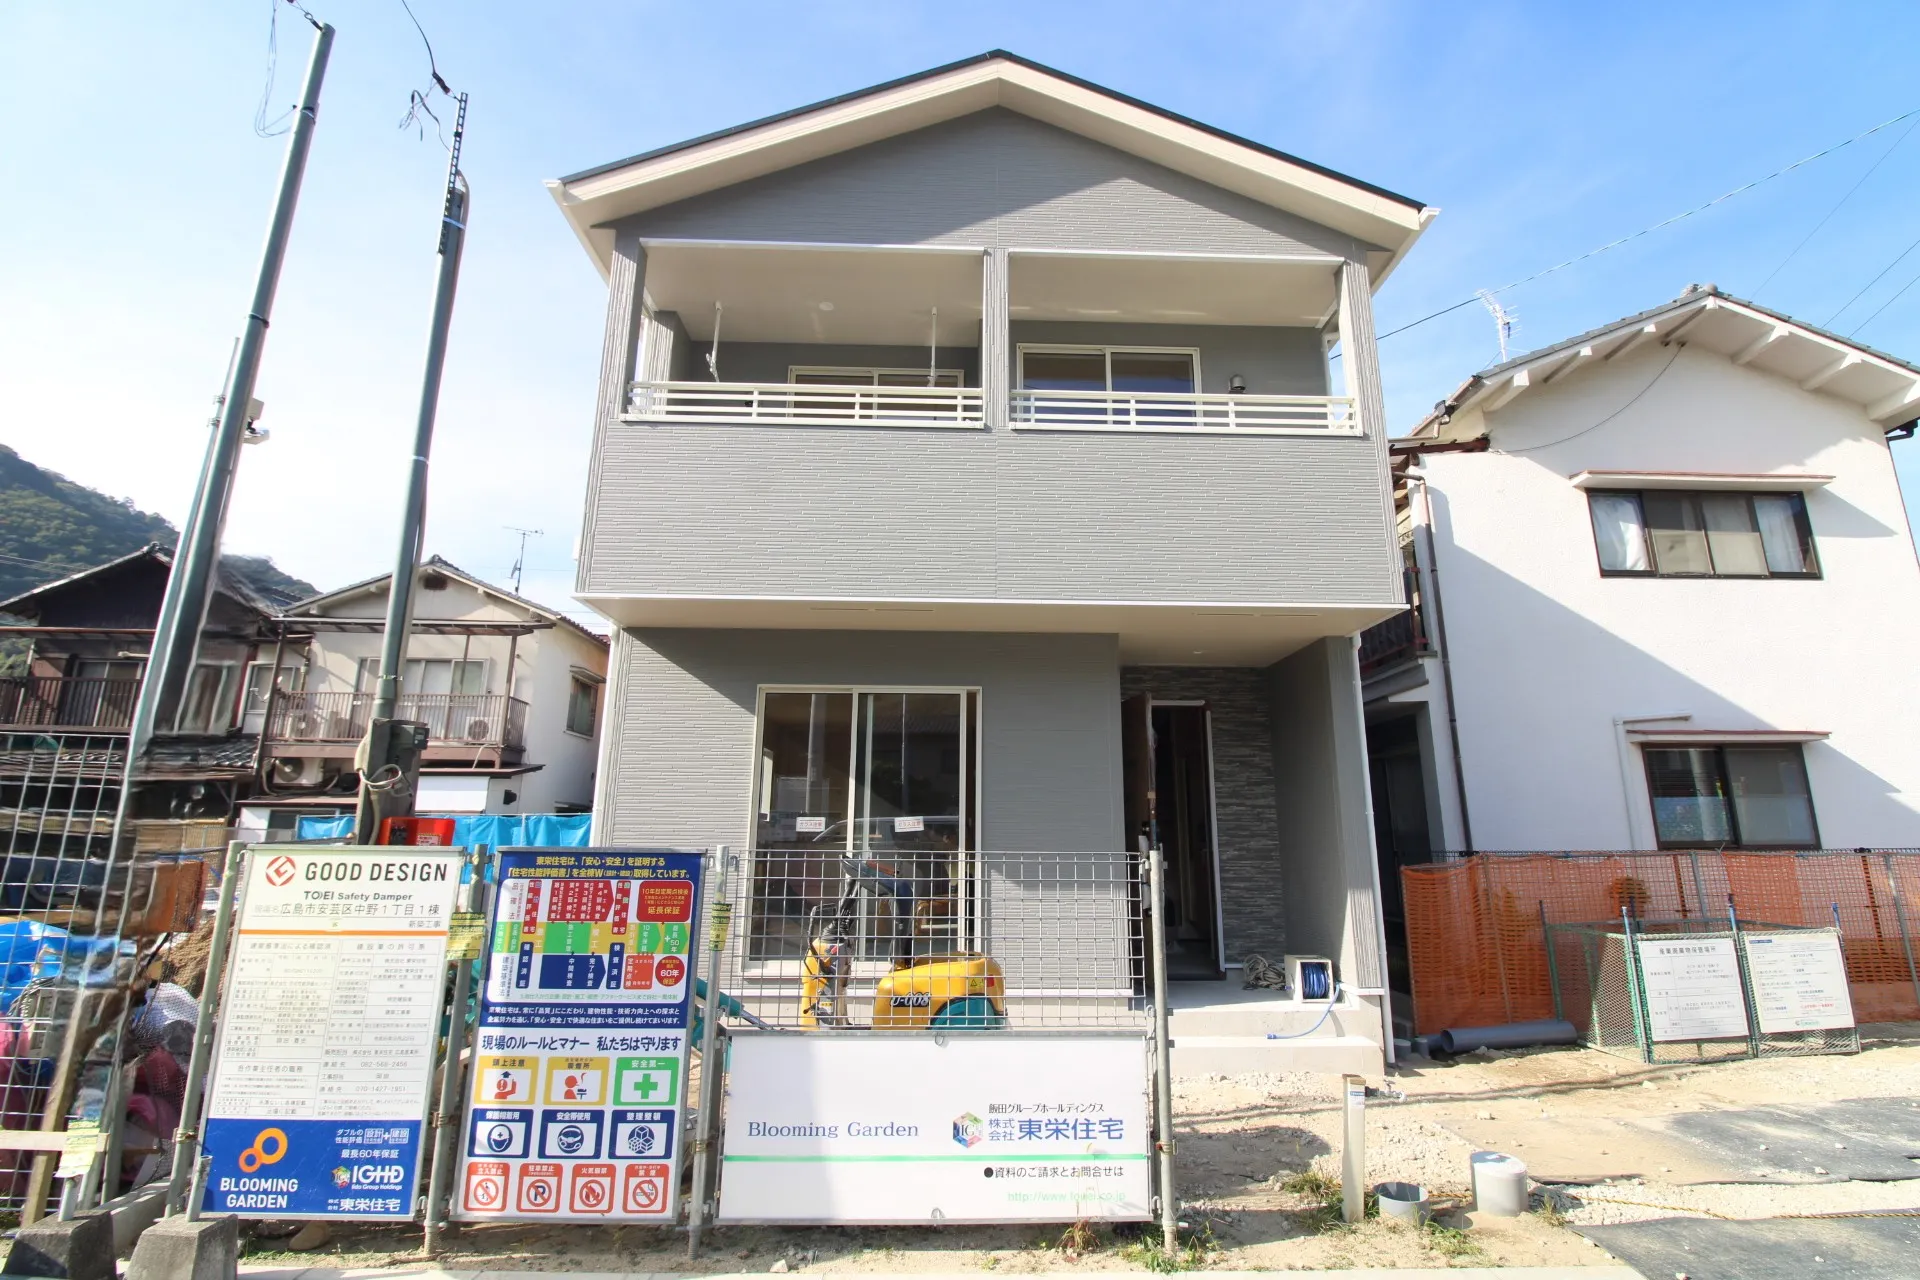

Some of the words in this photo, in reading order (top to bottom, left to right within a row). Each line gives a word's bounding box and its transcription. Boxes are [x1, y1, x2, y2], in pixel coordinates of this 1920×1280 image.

[305, 862, 362, 881] GOOD
[369, 863, 448, 881] DESIGN
[337, 892, 370, 902] Safety
[373, 893, 413, 902] Damper
[647, 906, 681, 915] 延長保証
[408, 920, 441, 929] 新築工事
[660, 969, 680, 977] 60年
[481, 1035, 590, 1050] 現場のルールとマナー
[596, 1035, 682, 1051] 私たちは守ります
[492, 1059, 525, 1067] 頭上注意
[631, 1060, 666, 1068] 安全第一
[988, 1103, 1105, 1114] 飯田グループホールディングス
[556, 1112, 591, 1120] 安全帯使用
[626, 1112, 661, 1120] 整理整頓
[336, 1128, 364, 1136] ダブルの
[747, 1121, 839, 1138] Blooming
[847, 1122, 920, 1137] Garden
[1017, 1118, 1124, 1141] 東栄住宅
[341, 1149, 400, 1159] 最長60年保証
[352, 1165, 404, 1184] IGHD
[220, 1178, 299, 1192] BLOOMING
[226, 1194, 288, 1208] GARDEN
[339, 1198, 401, 1211] 東栄住宅
